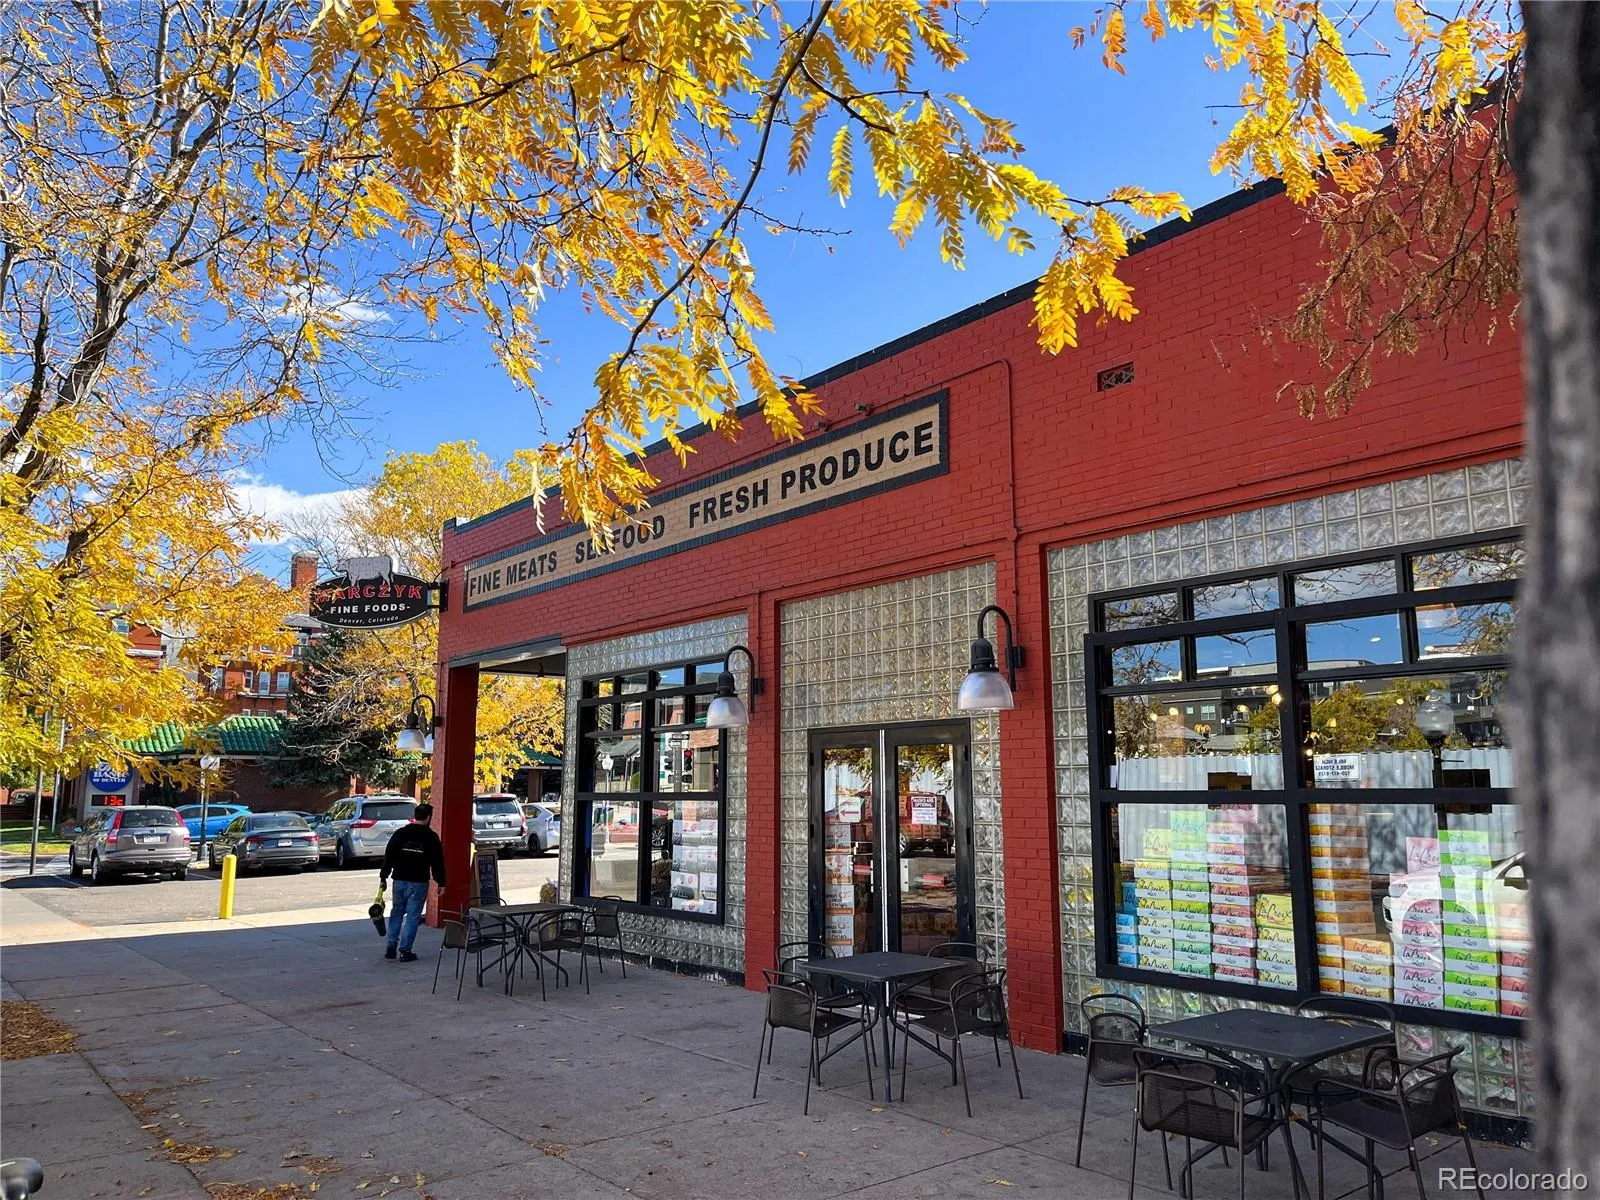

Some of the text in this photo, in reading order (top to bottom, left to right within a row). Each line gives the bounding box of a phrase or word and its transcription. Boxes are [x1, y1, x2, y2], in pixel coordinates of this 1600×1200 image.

[469, 567, 501, 597] FINE
[506, 550, 558, 586] MEATS
[689, 477, 769, 530] FRESH
[780, 421, 934, 501] PRODUCE
[368, 615, 399, 624] Colorado
